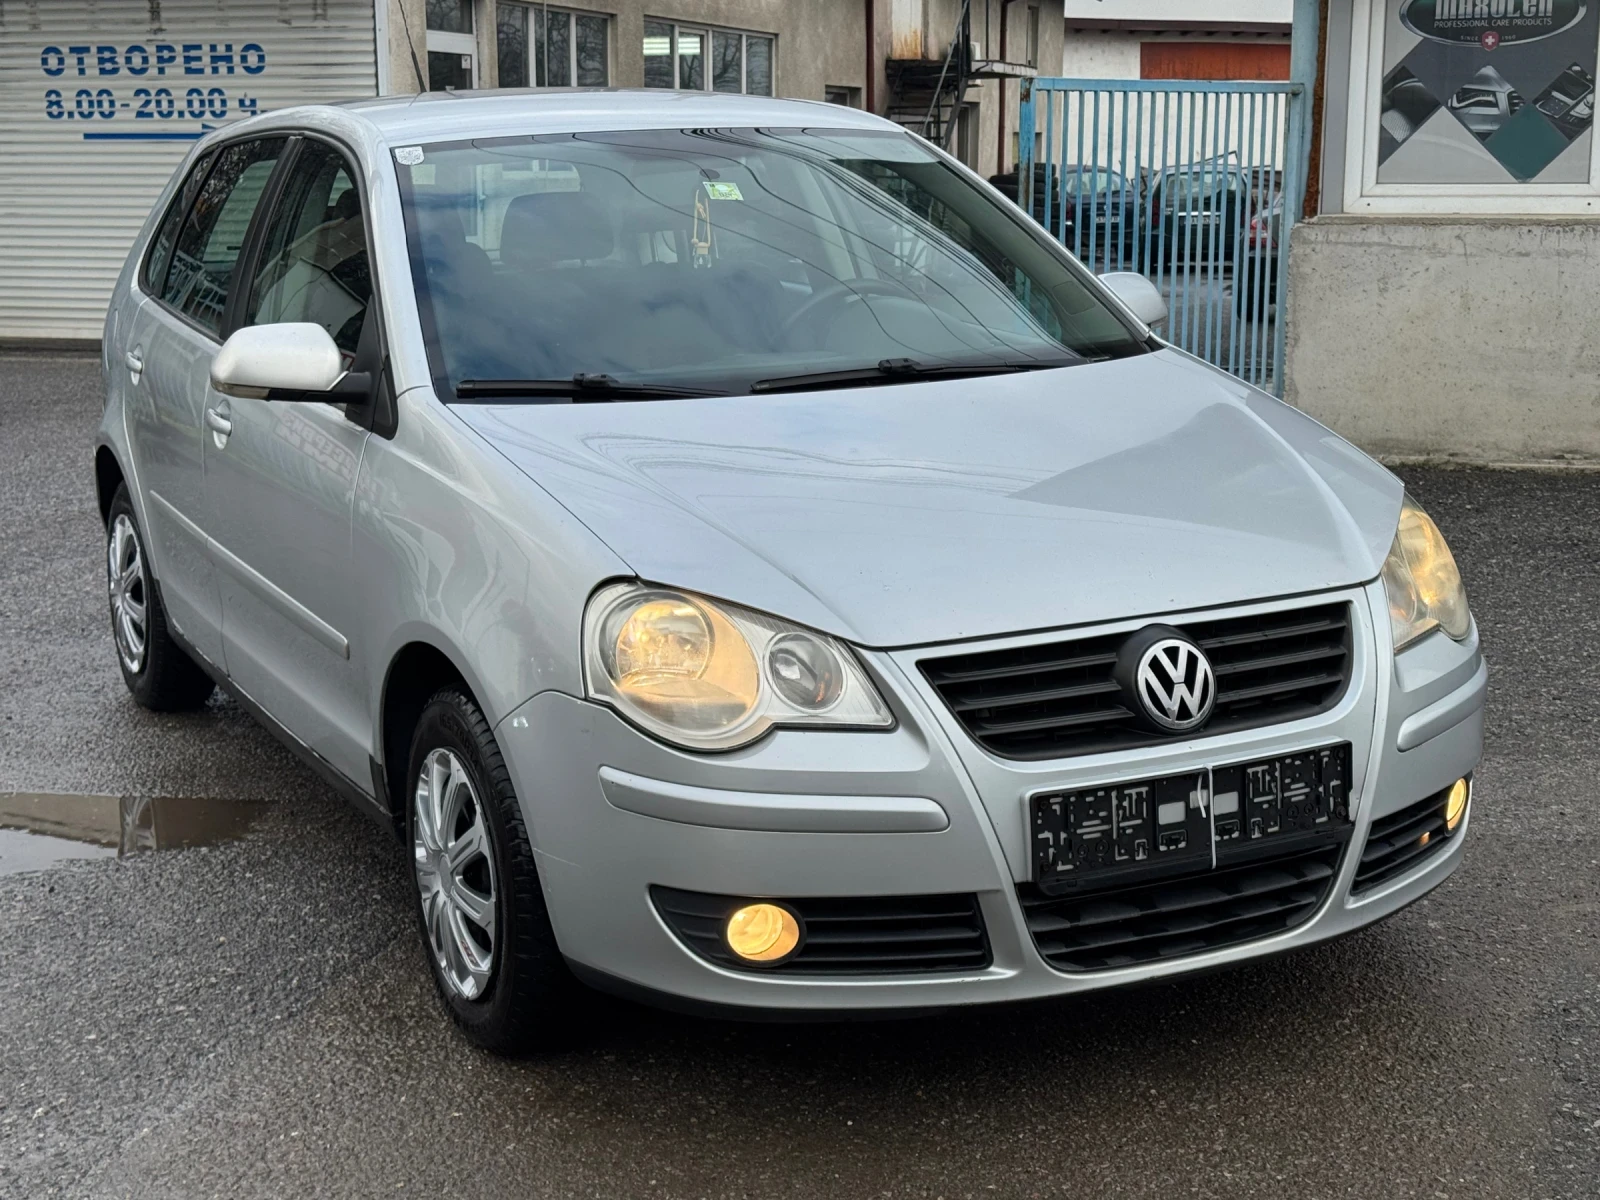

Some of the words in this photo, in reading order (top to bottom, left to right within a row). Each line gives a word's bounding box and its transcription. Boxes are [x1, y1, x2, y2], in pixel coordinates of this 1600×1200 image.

[1433, 20, 1489, 29] PROFESSIONAL
[1491, 19, 1510, 27] CARE
[1512, 18, 1553, 27] PRODUCTS
[41, 43, 267, 77] ОТВОРЕНО
[44, 88, 228, 120] 8.00-20.00
